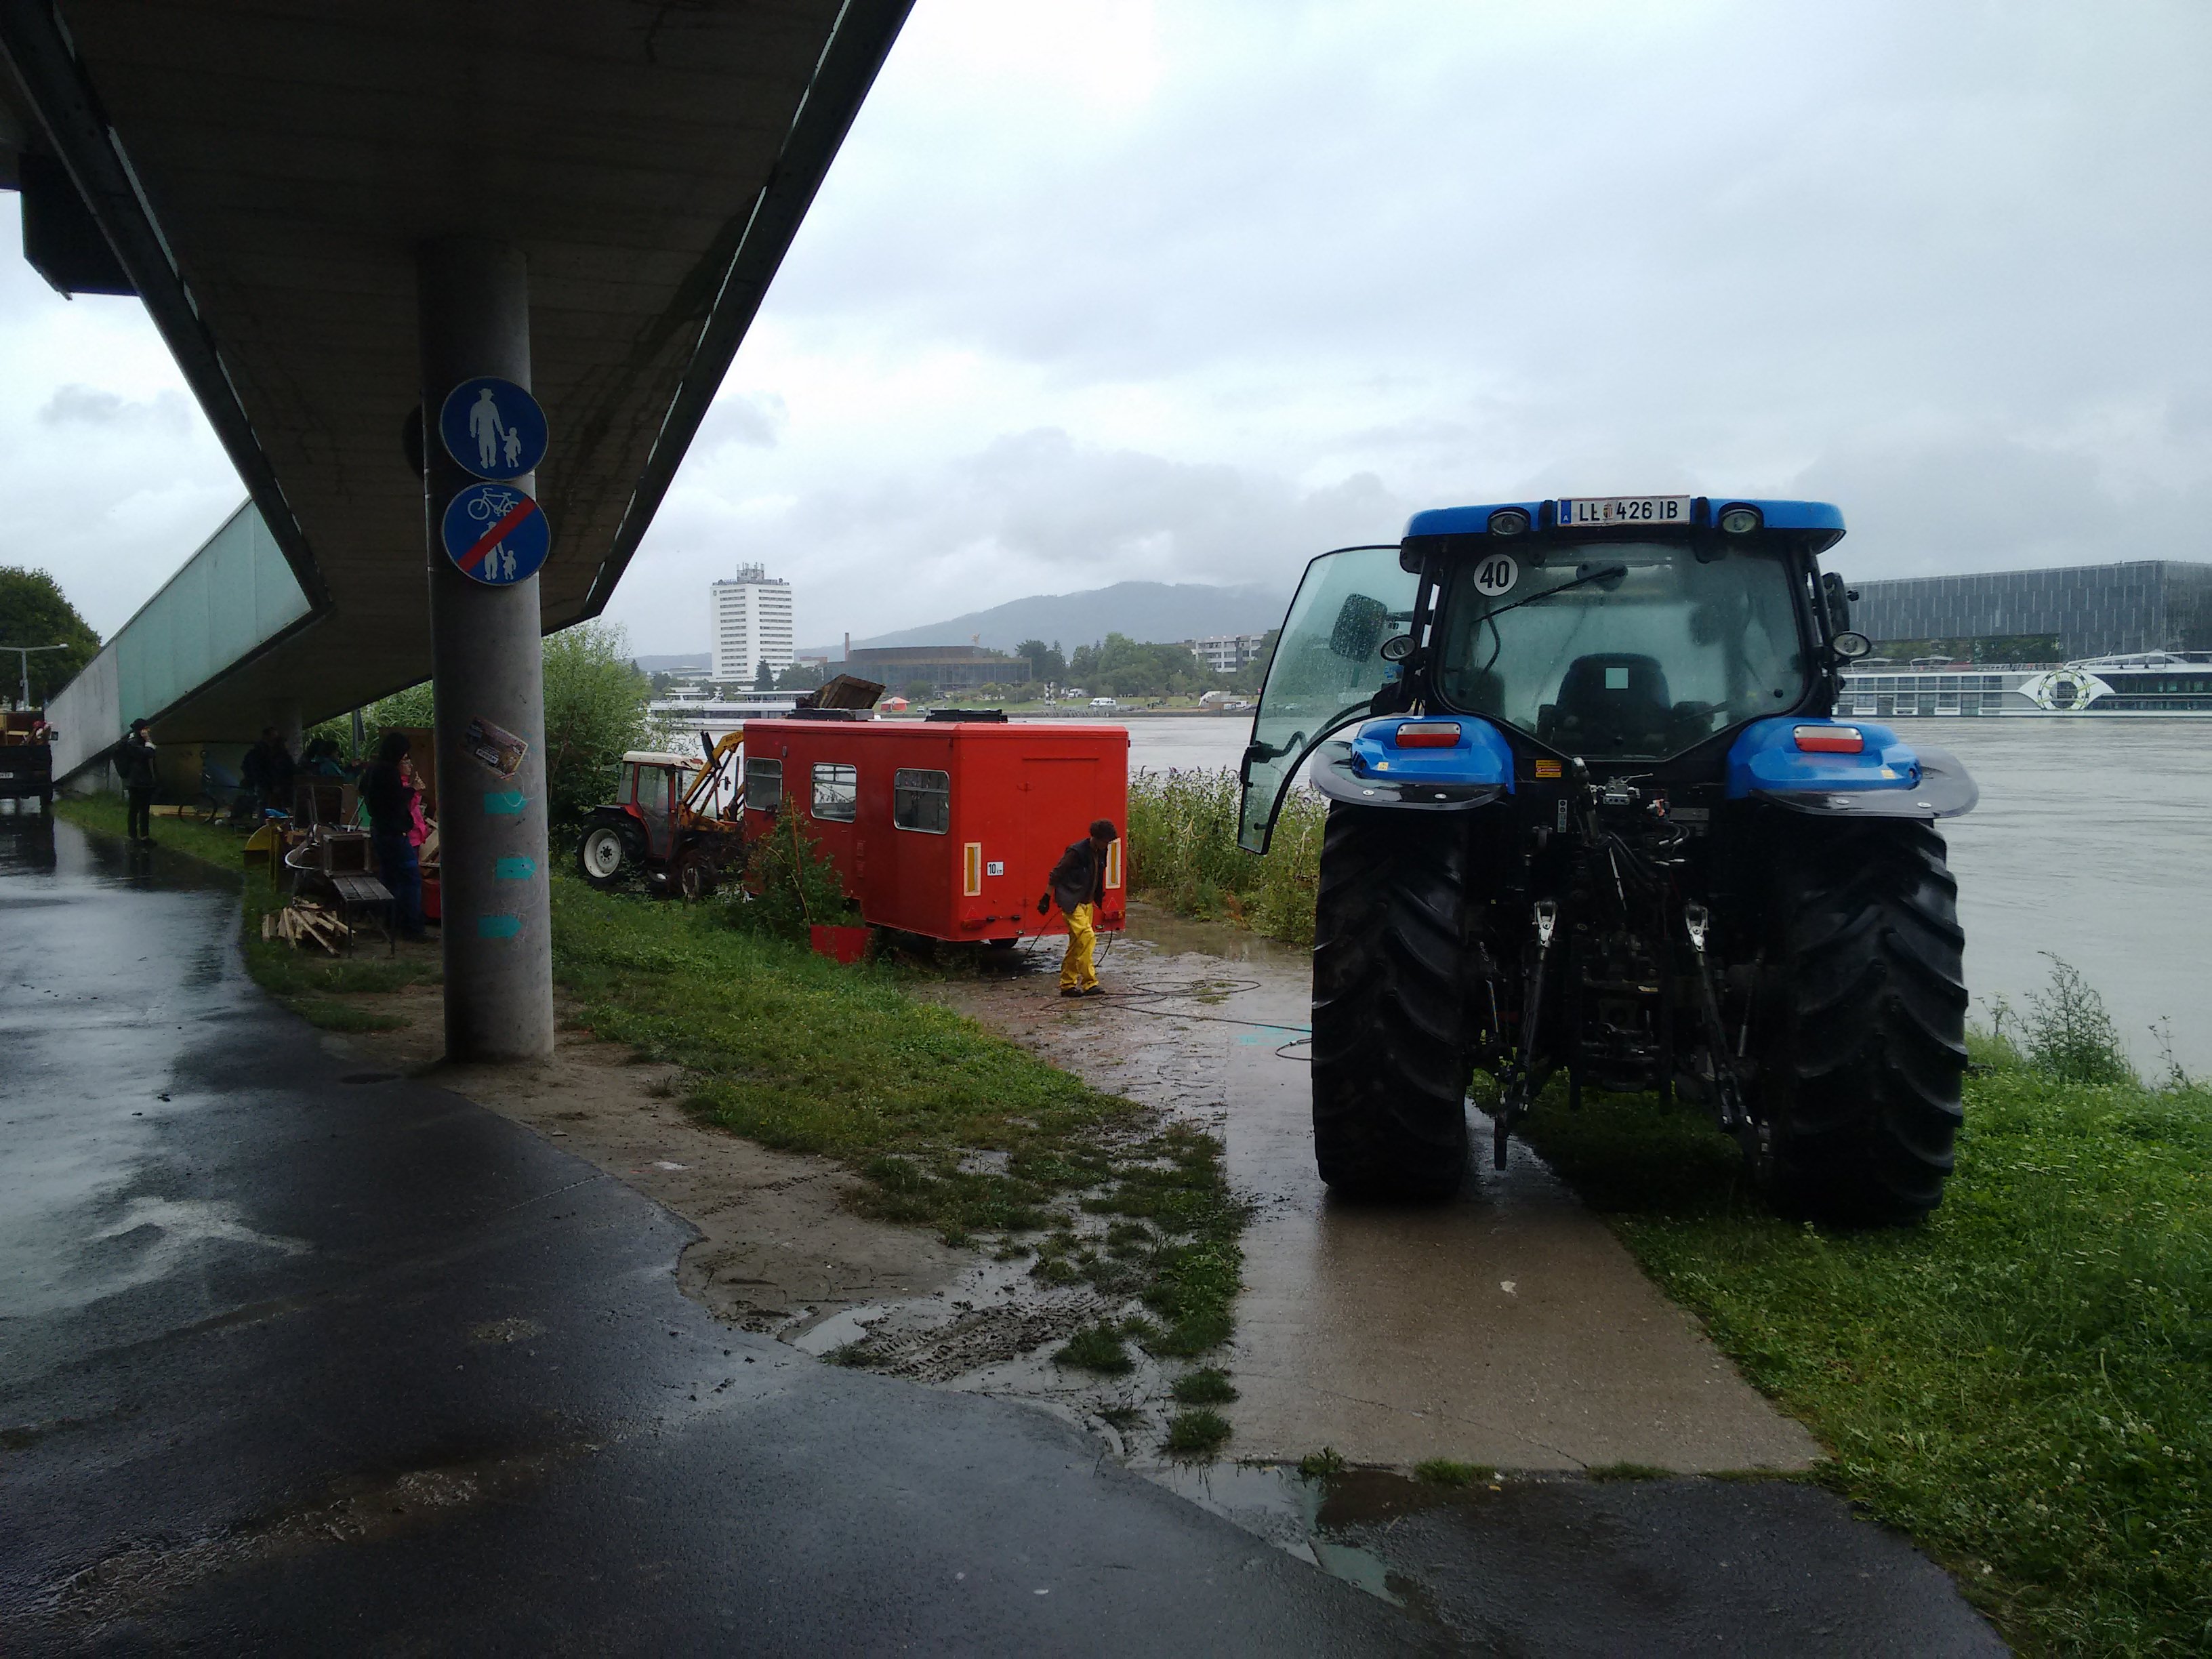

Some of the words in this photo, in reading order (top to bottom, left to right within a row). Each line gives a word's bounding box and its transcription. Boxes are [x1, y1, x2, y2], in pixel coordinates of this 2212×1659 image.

[1579, 503, 1600, 521] LL
[1616, 501, 1653, 520] 426
[1660, 500, 1678, 519] IB
[1479, 560, 1510, 588] 40
[988, 863, 996, 874] 10
